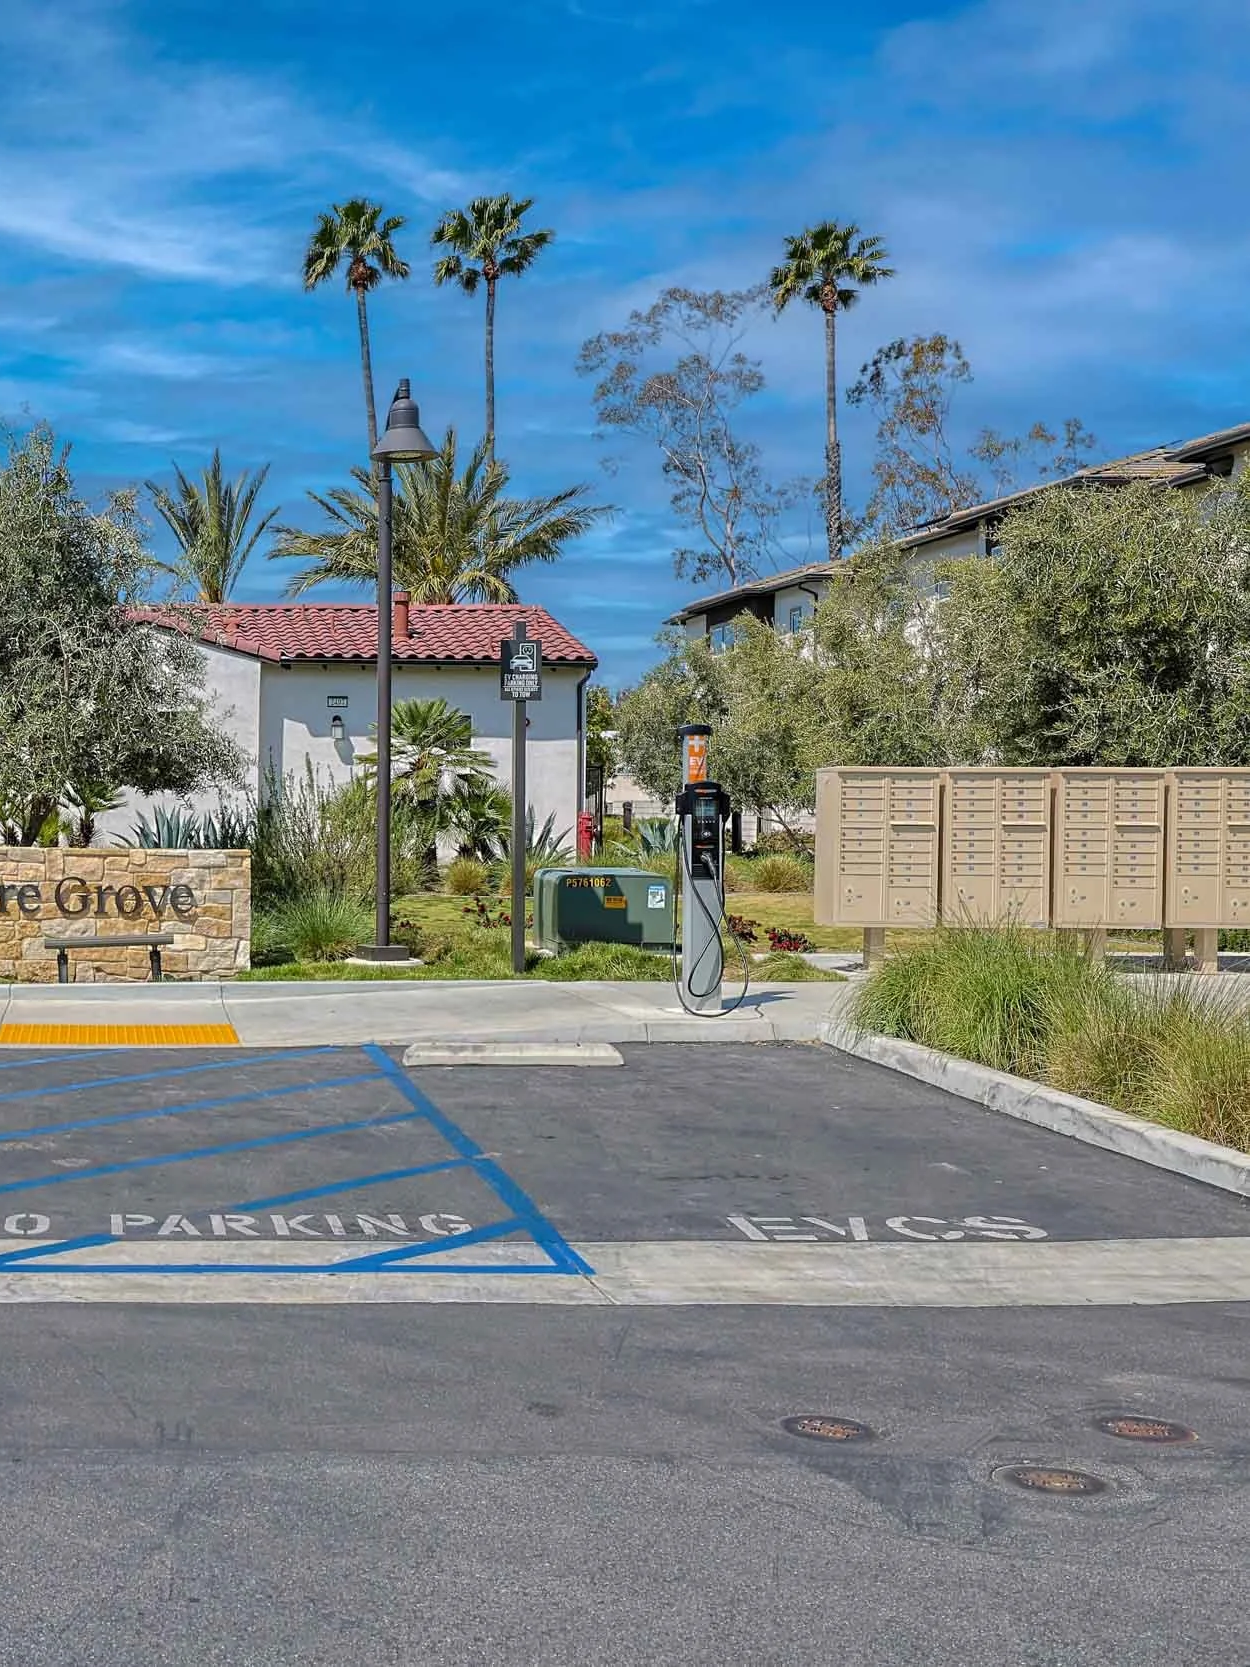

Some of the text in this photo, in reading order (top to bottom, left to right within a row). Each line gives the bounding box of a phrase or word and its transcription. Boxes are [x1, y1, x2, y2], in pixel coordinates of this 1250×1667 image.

[54, 876, 196, 915] Grove
[109, 1211, 474, 1237] PARKING
[726, 1215, 1048, 1241] EVCS
